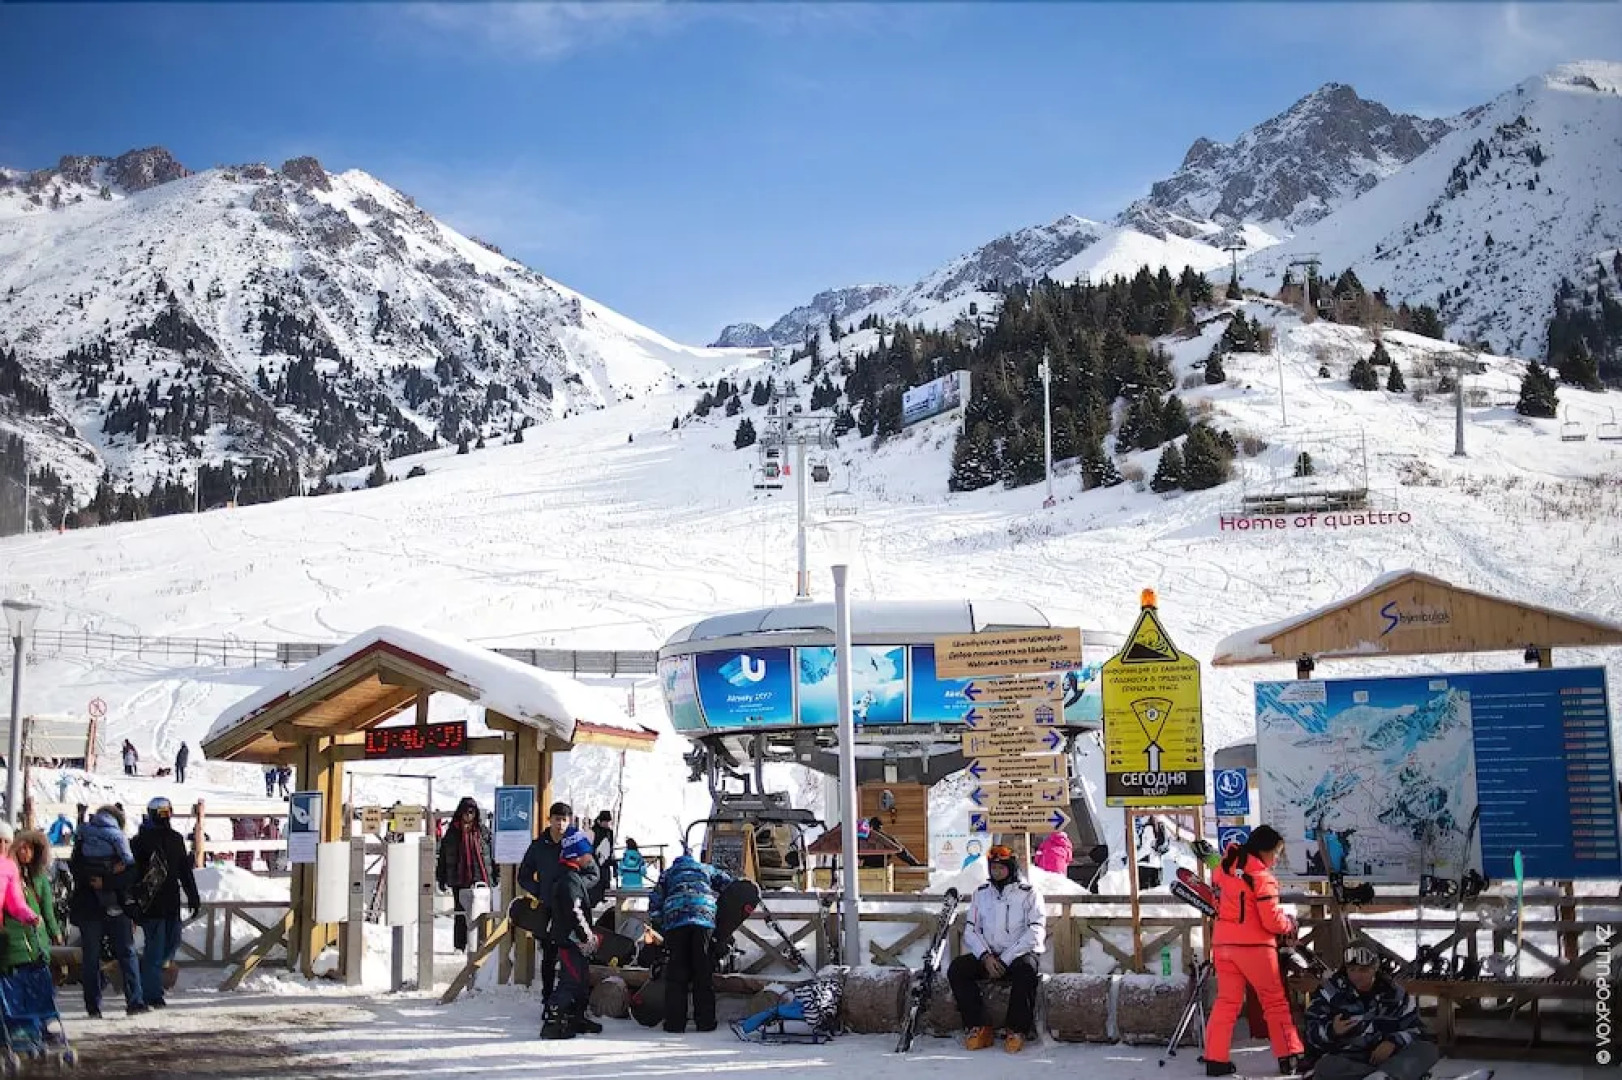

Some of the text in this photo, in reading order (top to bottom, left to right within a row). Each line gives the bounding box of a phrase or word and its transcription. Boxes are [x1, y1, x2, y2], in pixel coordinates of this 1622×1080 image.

[1219, 510, 1412, 530] Home of quattro
[1120, 771, 1188, 786] СЕГОДНЯ
